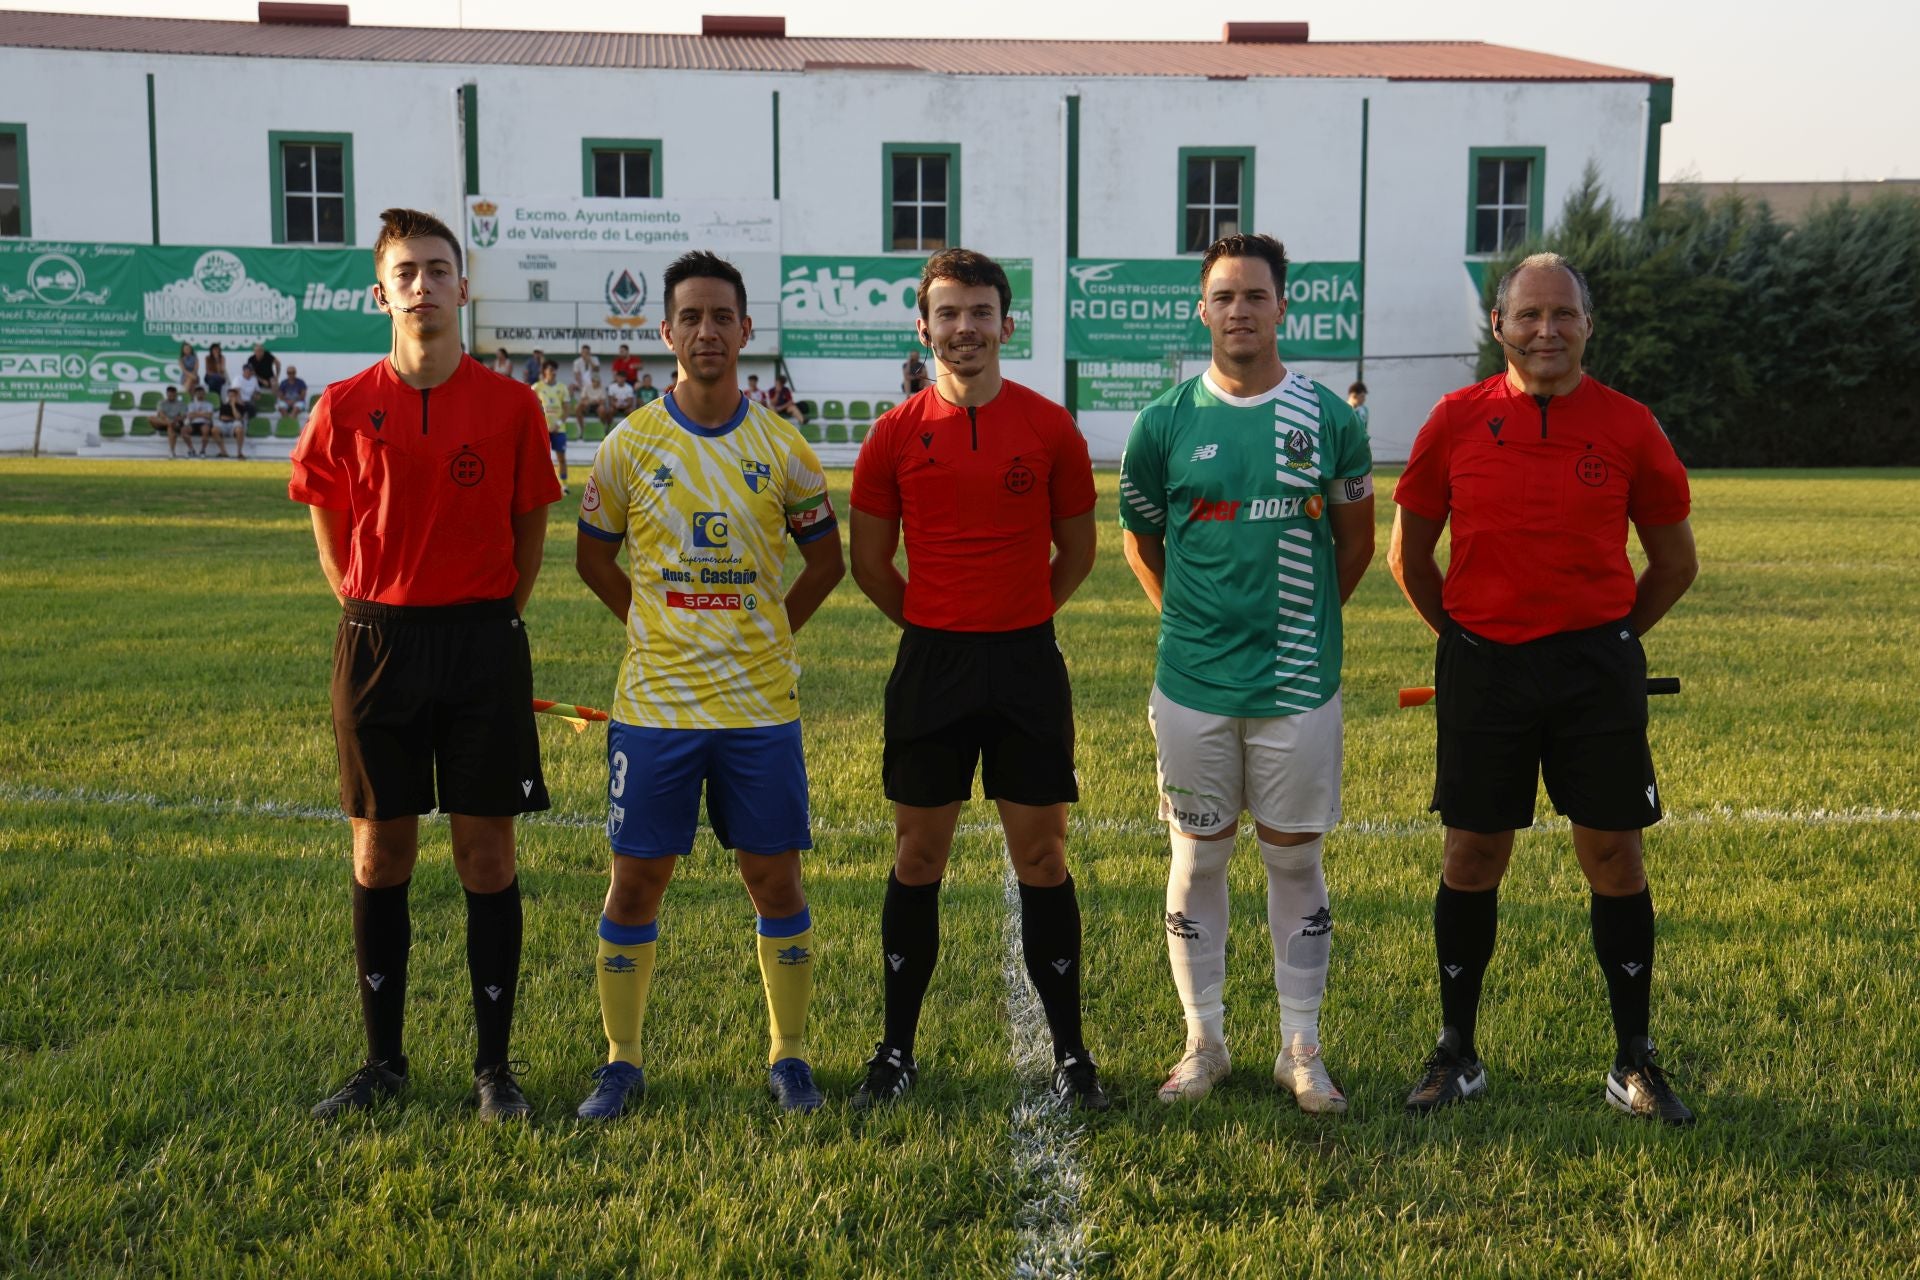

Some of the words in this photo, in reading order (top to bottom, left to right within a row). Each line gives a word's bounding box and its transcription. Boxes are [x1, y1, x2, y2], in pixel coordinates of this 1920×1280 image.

[515, 208, 570, 221] Excmo.
[575, 209, 681, 224] Ayuntamiento
[507, 228, 526, 240] de
[530, 227, 597, 241] Valverde
[602, 229, 621, 241] de
[625, 229, 690, 244] Leganés
[496, 328, 537, 341] EXCMO.
[538, 328, 618, 341] AYUNTAMIENTO
[620, 329, 634, 341] DE
[1142, 381, 1162, 390] PVC
[1345, 476, 1365, 501] C
[1249, 496, 1303, 520] DOEX
[679, 552, 742, 567] Supermercados
[662, 568, 694, 583] Hnos.
[700, 567, 757, 585] Castaño
[684, 596, 739, 607] SPAR
[611, 751, 628, 798] 3
